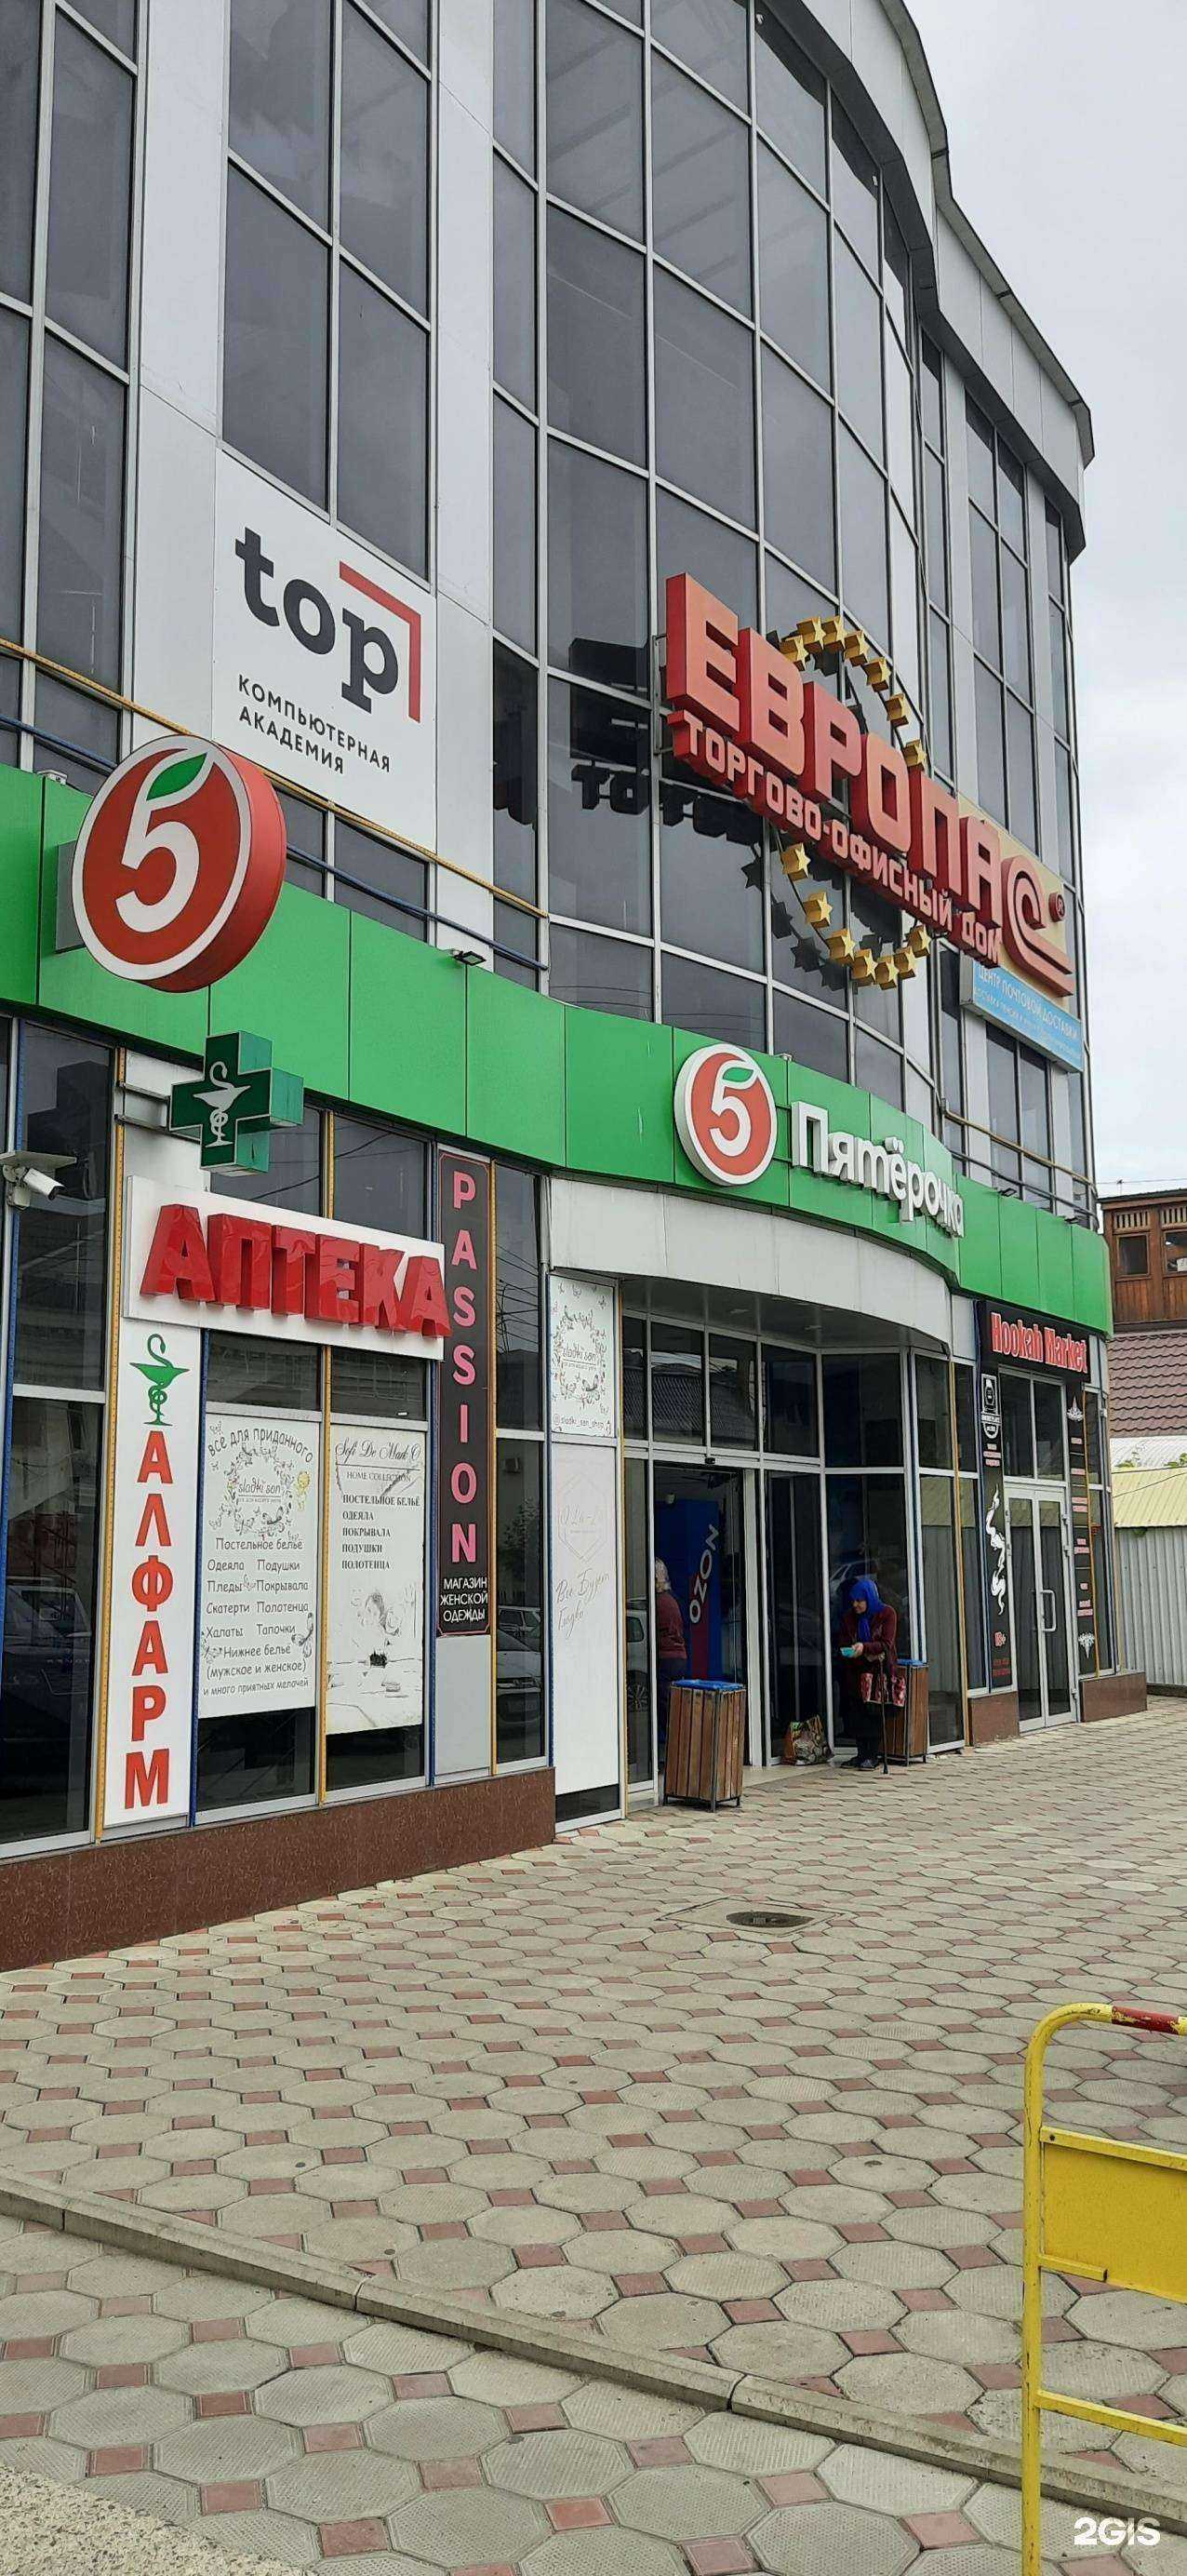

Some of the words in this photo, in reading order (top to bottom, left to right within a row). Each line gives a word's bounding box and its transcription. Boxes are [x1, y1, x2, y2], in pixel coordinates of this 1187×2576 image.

[235, 527, 398, 713] top
[238, 674, 391, 772] КОМПЬЮТЕРНАЯ
[239, 705, 344, 775] АКАДЕМИЯ
[666, 572, 1002, 924] ЕВРОПА
[115, 748, 208, 933] 5
[667, 710, 954, 933] ТОРГОВО-ОФИСНЫЙ
[960, 911, 1003, 969] ДОМ
[709, 1059, 758, 1157] 5
[792, 1101, 964, 1238] Пятёрочка
[140, 1203, 452, 1338] АПТЕКА
[991, 1311, 1043, 1363] Hookah
[1044, 1326, 1088, 1375] Market
[451, 1170, 477, 1564] PASSION
[230, 1429, 250, 1446] для
[253, 1428, 313, 1463] приданного
[347, 1470, 367, 1480] HOME
[342, 1494, 395, 1506] ПОСТЕЛЬНОЕ
[342, 1510, 374, 1521] ОДЕЯЛА
[342, 1527, 391, 1537] ПОКРЫВАЛА
[216, 1537, 273, 1550] Постельное
[342, 1543, 382, 1553] ПОДУШКИ
[207, 1559, 245, 1571] Одеяла
[257, 1559, 300, 1575] Подушки
[341, 1560, 390, 1570] ПОЛОТЕНЦА
[689, 1523, 719, 1624] OZON
[207, 1580, 242, 1593] Пледы
[256, 1579, 309, 1594] Покрывала
[444, 1576, 487, 1590] МАГАЗИН
[440, 1590, 488, 1606] ЖЕНСКОЙ
[207, 1602, 250, 1616] Скатерти
[257, 1601, 309, 1615] Полотенца
[443, 1608, 486, 1623] ОДЕЖДЫ
[125, 1429, 174, 1811] АЛФАРМ
[206, 1627, 244, 1639] Халаты
[257, 1623, 296, 1635] Тапочки
[223, 1646, 261, 1657] Нижнее
[207, 1664, 252, 1681] (мужское
[255, 1664, 261, 1674] и
[264, 1659, 307, 1674] женское)
[203, 1686, 208, 1696] и
[210, 1684, 235, 1697] много
[237, 1682, 274, 1694] приятных
[276, 1676, 309, 1689] мелочей
